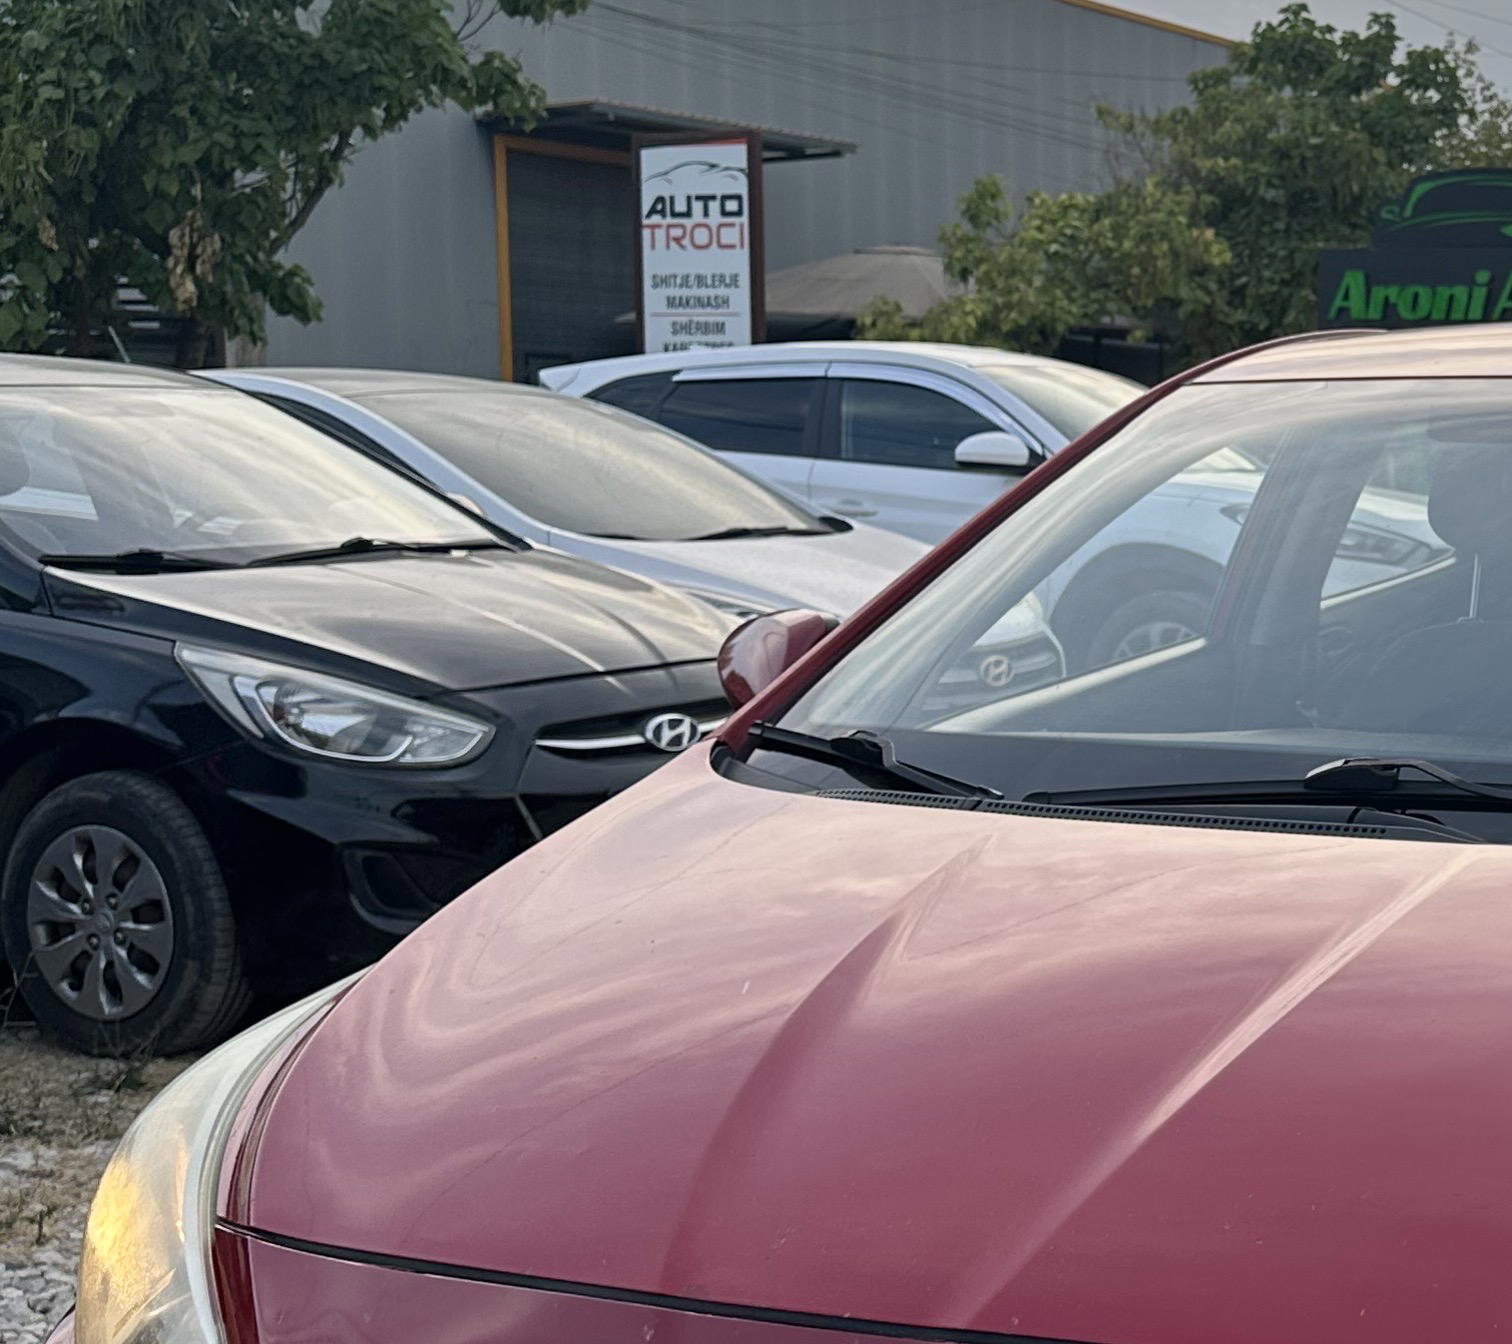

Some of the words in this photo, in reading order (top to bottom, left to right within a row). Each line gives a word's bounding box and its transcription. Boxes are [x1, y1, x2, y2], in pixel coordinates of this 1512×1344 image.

[645, 194, 744, 219] AUTO
[641, 222, 745, 251] TROCI
[666, 295, 730, 310] MAKINASH
[1328, 269, 1491, 321] Aroni
